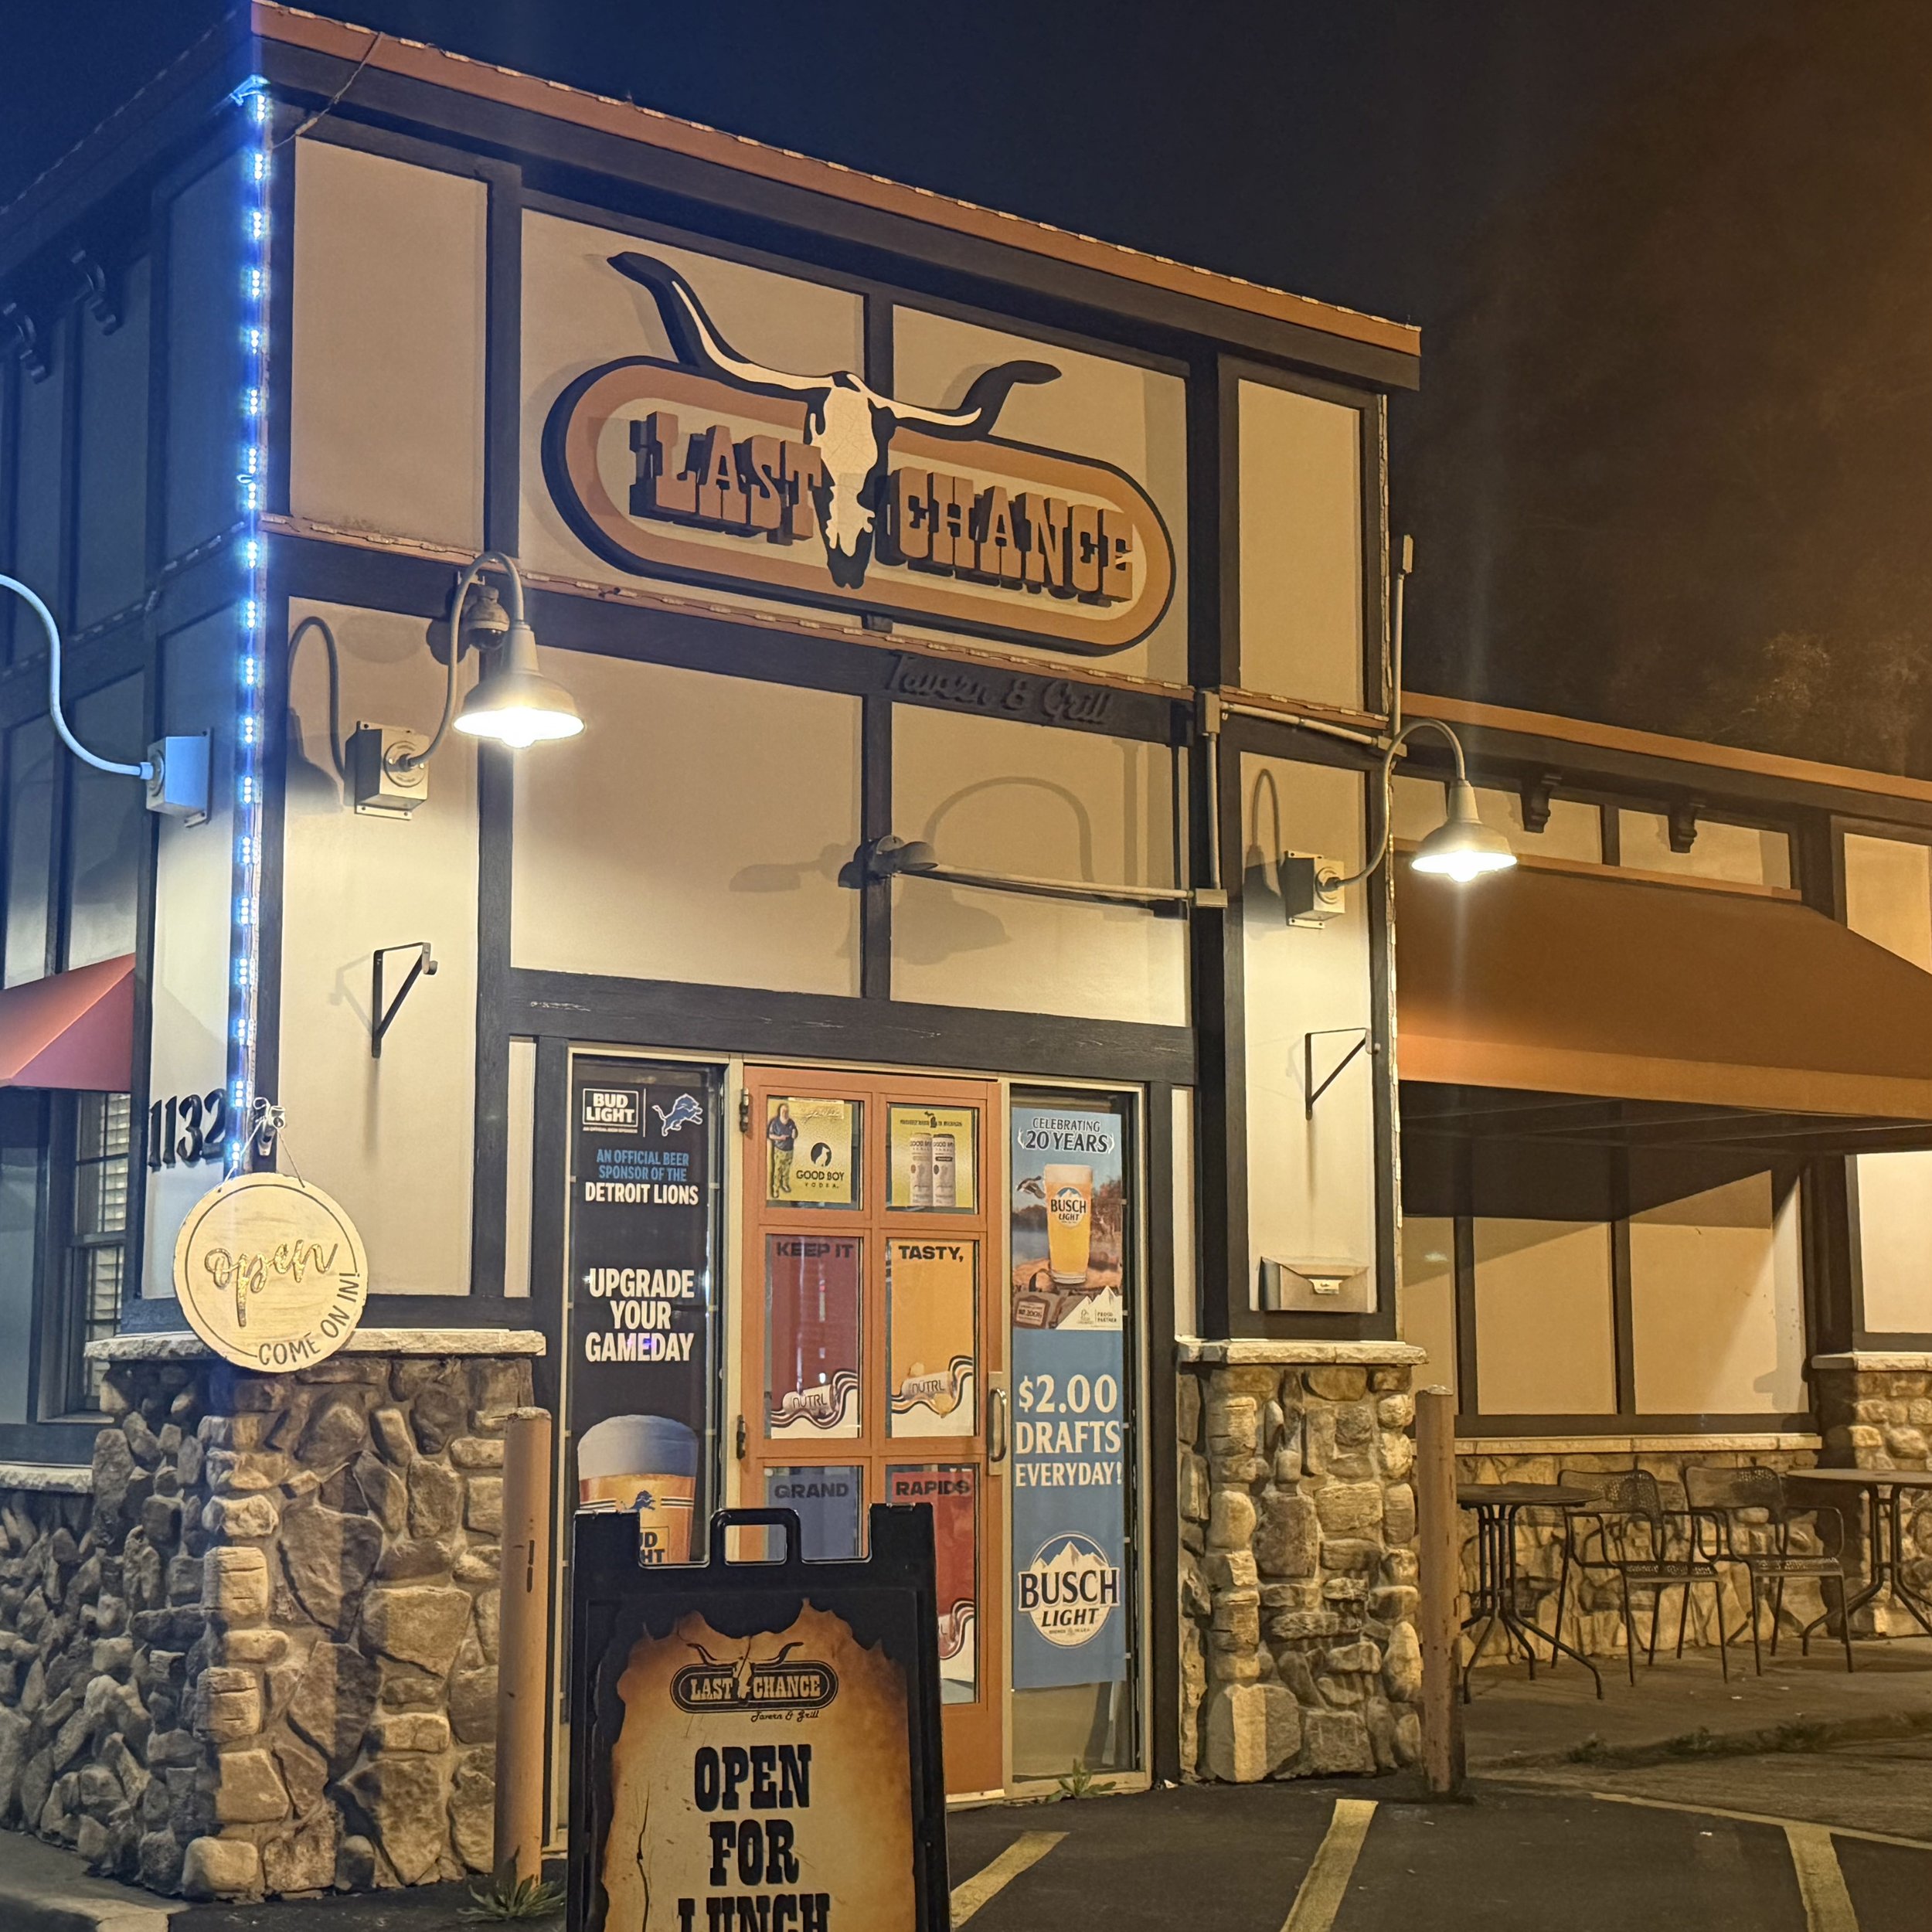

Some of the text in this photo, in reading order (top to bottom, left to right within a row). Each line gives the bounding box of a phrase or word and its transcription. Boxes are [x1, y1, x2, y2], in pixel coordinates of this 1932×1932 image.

[630, 411, 1133, 604] LAST CHANCE
[1040, 678, 1114, 725] Grill
[593, 1093, 628, 1108] BUD
[586, 1106, 635, 1123] LIGHT
[1032, 1117, 1100, 1132] CELEBRATING
[148, 1088, 226, 1167] 1132
[1026, 1130, 1107, 1152] 20 YEARS
[597, 1148, 689, 1167] AN OFFICIAL BEER
[598, 1165, 687, 1182] SPONSOR OF THE
[796, 1170, 845, 1182] GOOD BOY
[585, 1182, 699, 1205] DETROIT LIONS
[1051, 1199, 1087, 1213] BUSCH
[777, 1241, 855, 1258] KEEP IT
[898, 1245, 964, 1263] TASTY,
[590, 1268, 695, 1298] UPGRADE
[259, 1272, 360, 1366] COME ON IN!
[610, 1300, 672, 1329] YOUR
[585, 1332, 695, 1362] GAMEDAY
[1019, 1374, 1117, 1413] $2.00
[1015, 1420, 1121, 1454] DRAFTS
[1015, 1461, 1122, 1487] EVERYDAY!
[774, 1483, 849, 1498] GRAND
[896, 1480, 970, 1496] RAPIDS
[1020, 1570, 1118, 1608] BUSCH
[1041, 1608, 1100, 1627] LIGHT
[690, 1675, 821, 1701] LAST CHANCE
[750, 1709, 820, 1723] Tavern & Grill
[695, 1743, 812, 1812] OPEN
[709, 1818, 799, 1886] FOR
